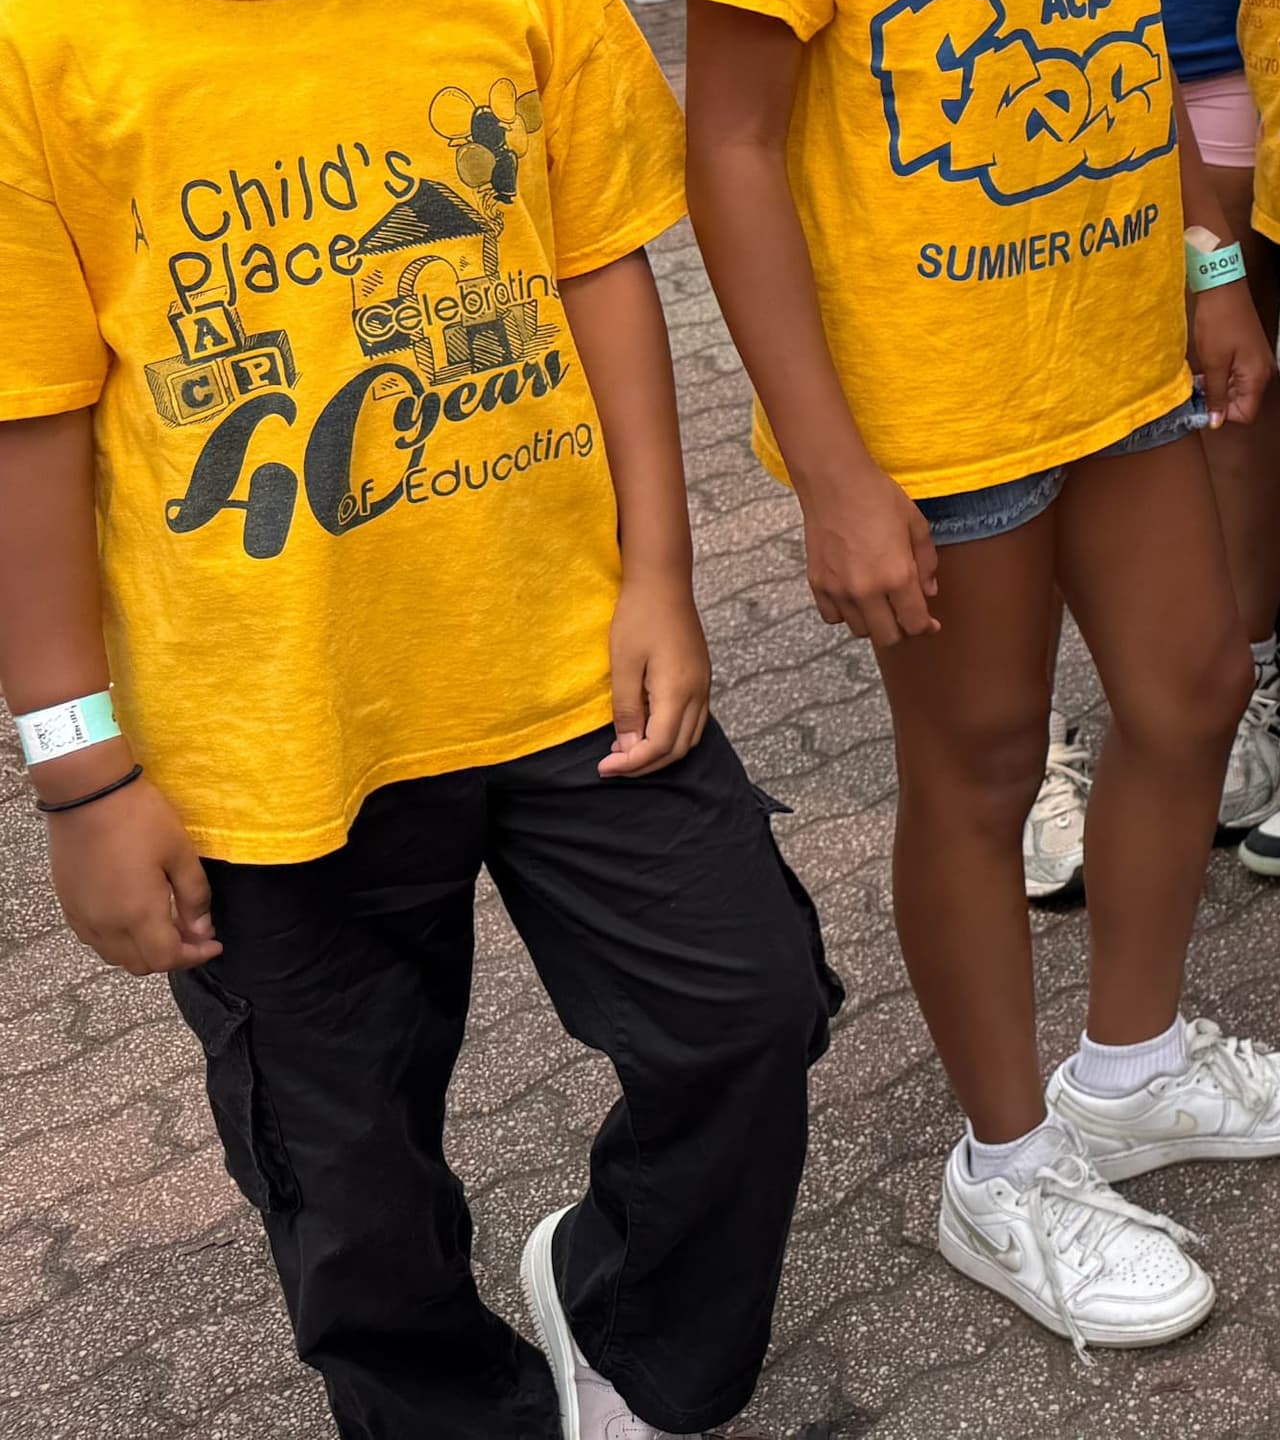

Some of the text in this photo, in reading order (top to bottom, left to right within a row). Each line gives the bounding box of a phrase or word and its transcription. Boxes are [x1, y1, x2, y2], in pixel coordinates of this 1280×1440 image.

[181, 141, 421, 242] Child's
[168, 230, 363, 316] Place
[917, 203, 1160, 282] SUMMER CAMP
[394, 350, 570, 449] years
[405, 421, 594, 504] Educating
